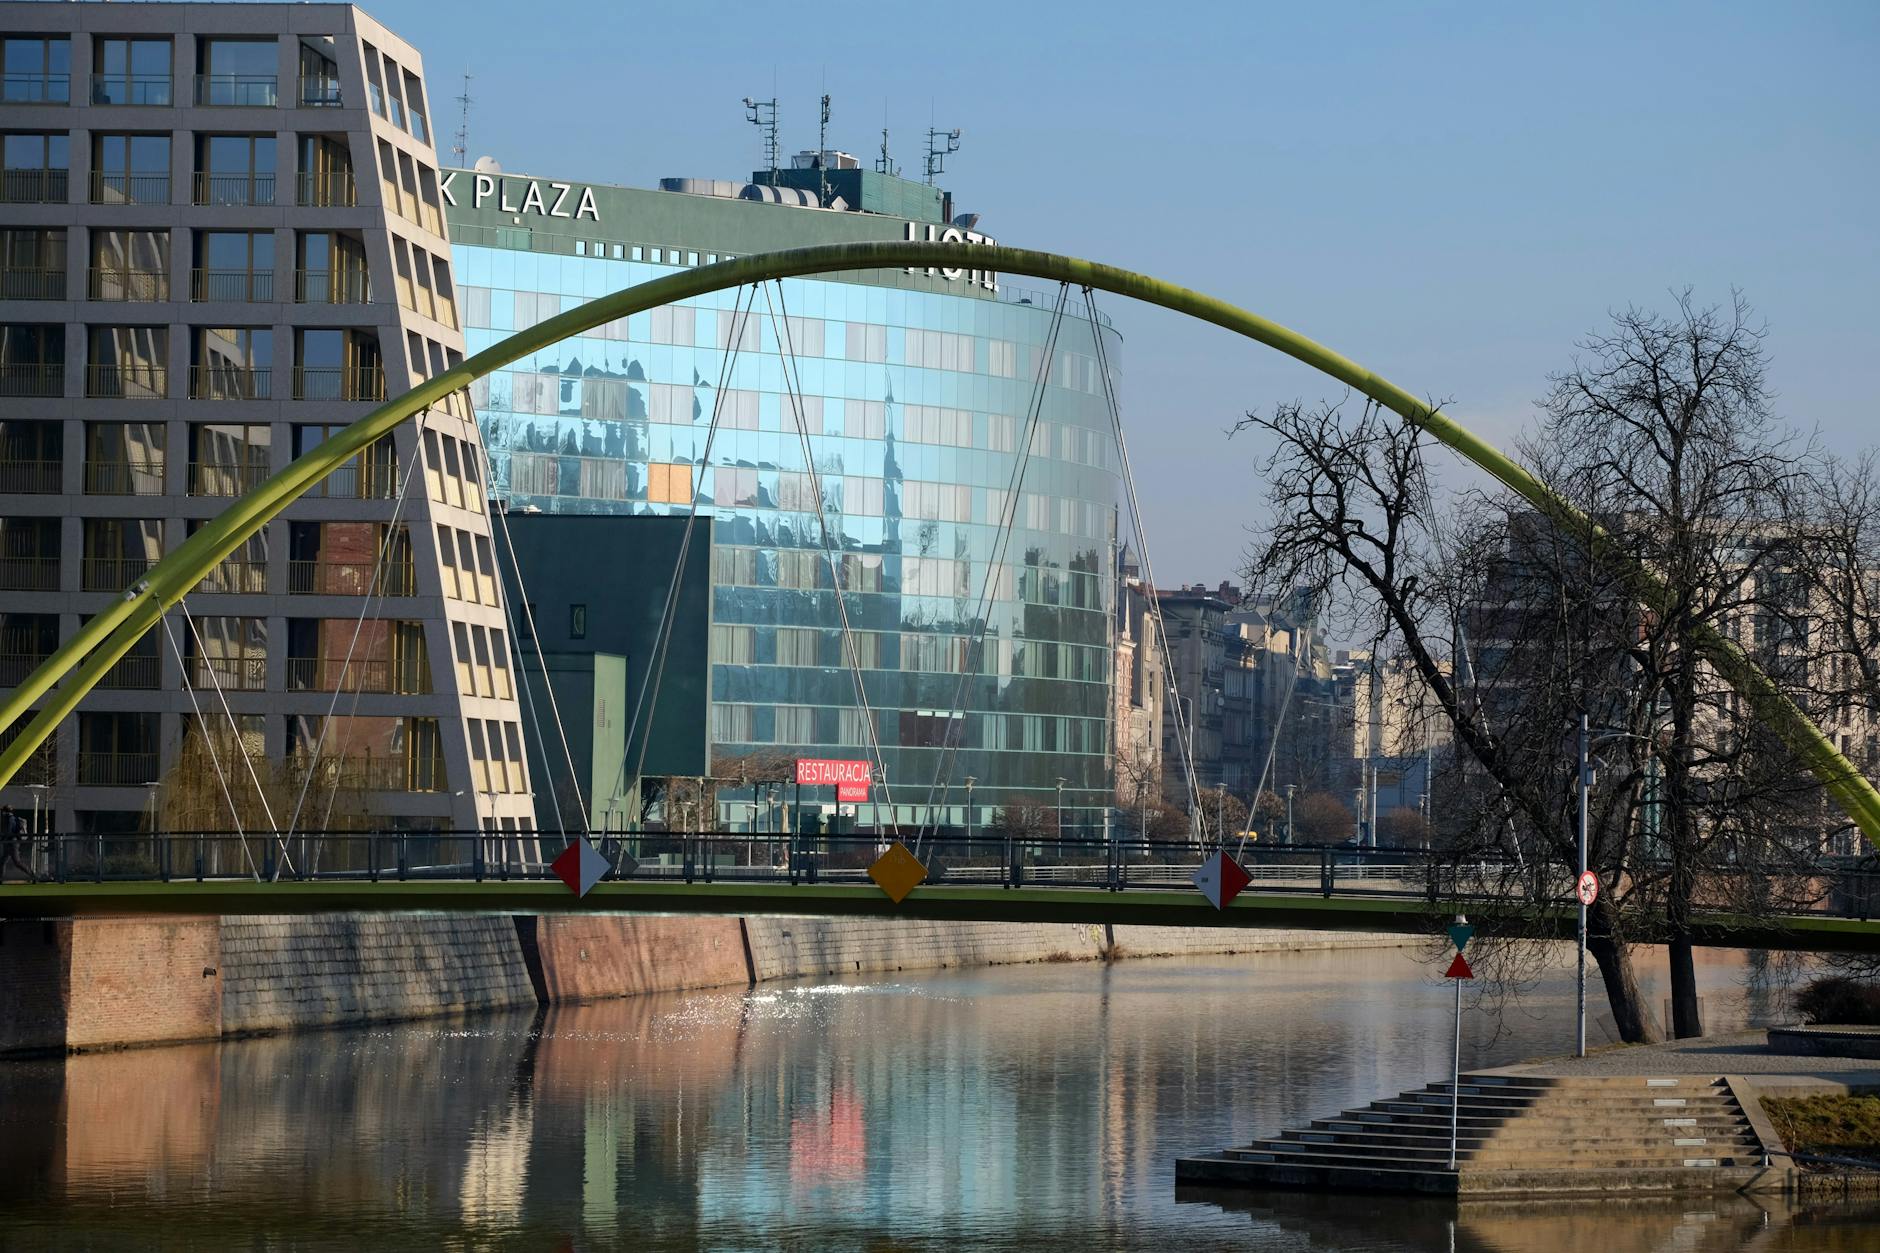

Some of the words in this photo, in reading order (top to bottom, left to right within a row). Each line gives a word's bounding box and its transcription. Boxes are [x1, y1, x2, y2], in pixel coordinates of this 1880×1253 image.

[473, 174, 600, 222] PLAZA
[798, 762, 872, 782] RESTAURACJA
[840, 786, 867, 798] PANORAMA
